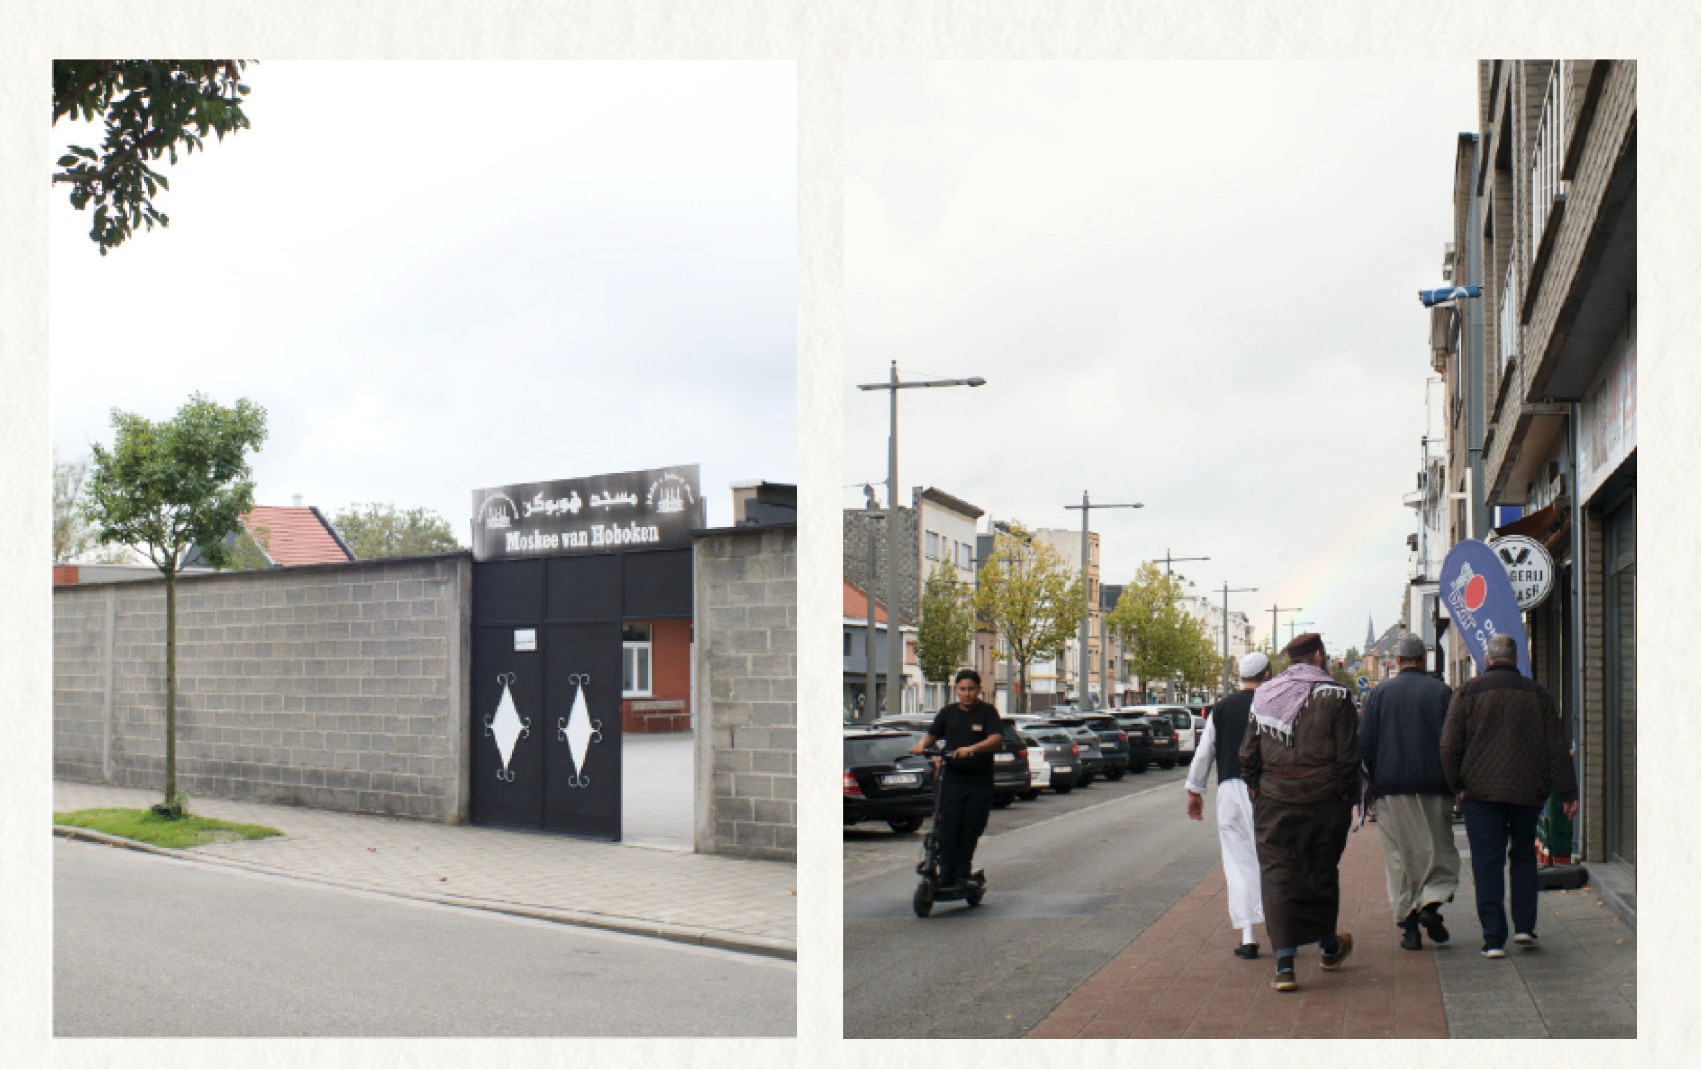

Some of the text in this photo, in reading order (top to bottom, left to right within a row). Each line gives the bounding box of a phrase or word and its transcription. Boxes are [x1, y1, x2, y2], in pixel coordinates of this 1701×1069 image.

[589, 489, 639, 511] مسجد
[506, 520, 660, 552] Moskee van Hoboken
[1509, 569, 1544, 582] GERIJ
